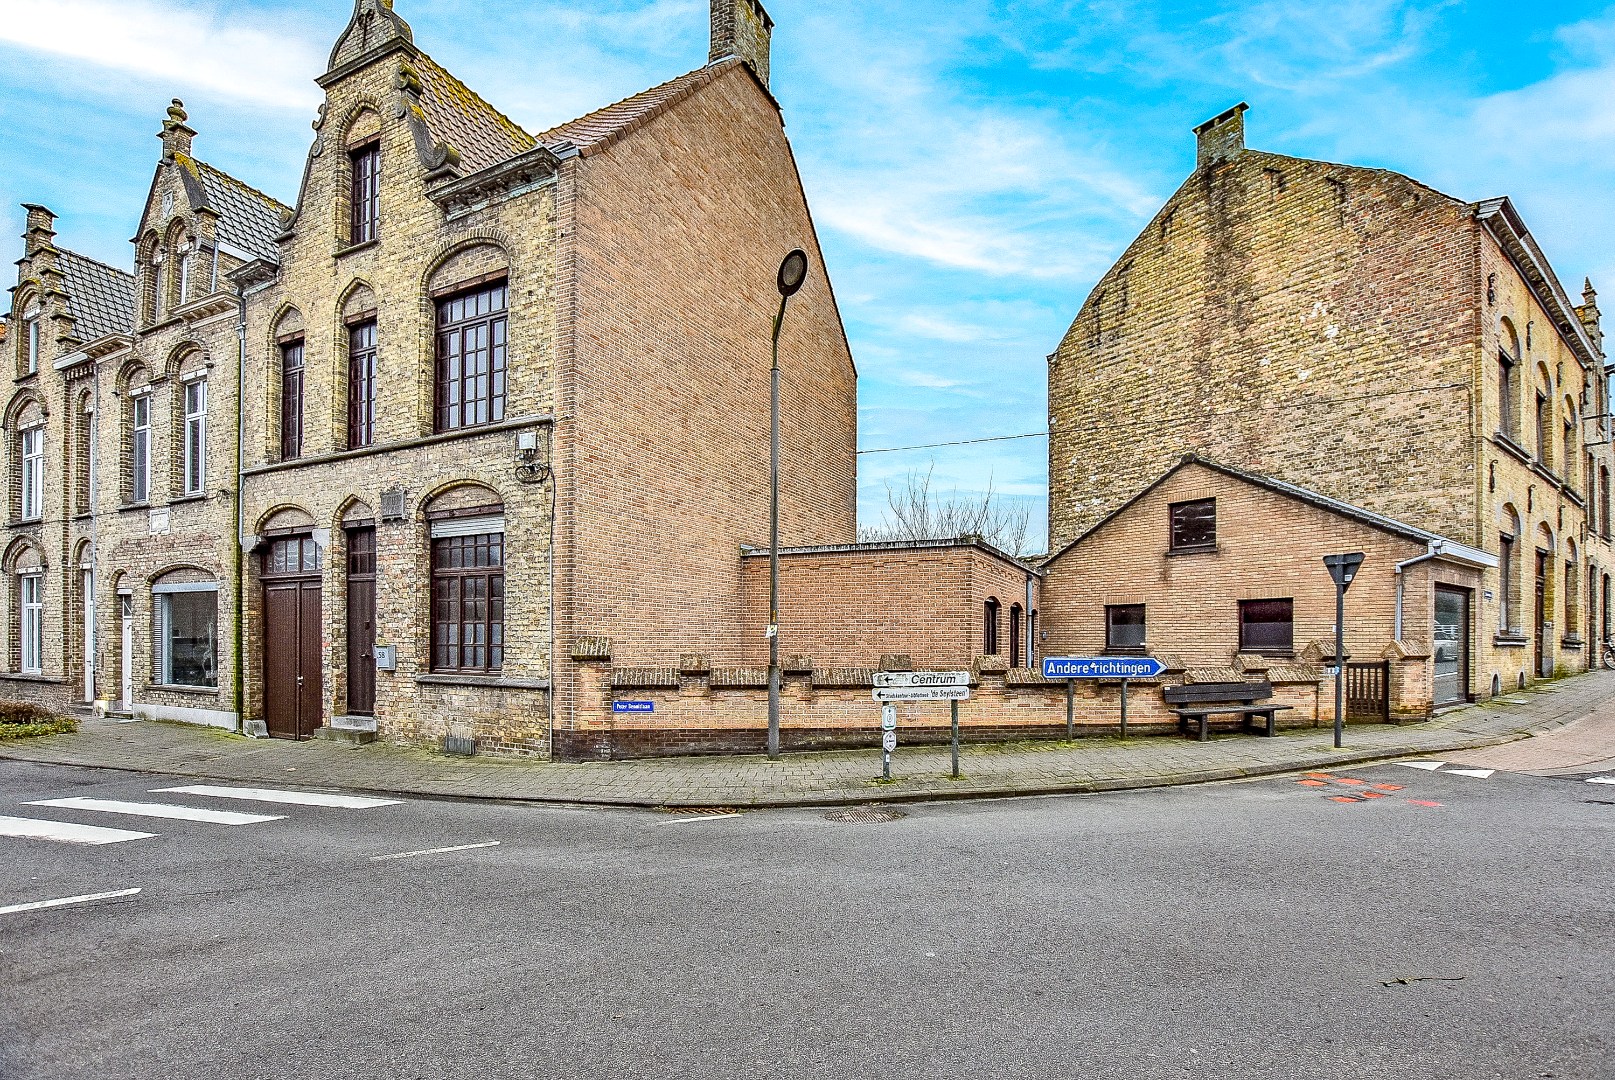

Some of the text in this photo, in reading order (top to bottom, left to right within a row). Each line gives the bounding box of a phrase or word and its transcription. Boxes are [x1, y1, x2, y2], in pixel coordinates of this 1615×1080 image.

[1047, 661, 1151, 676] Andere richtingen
[911, 674, 956, 684] Centrum
